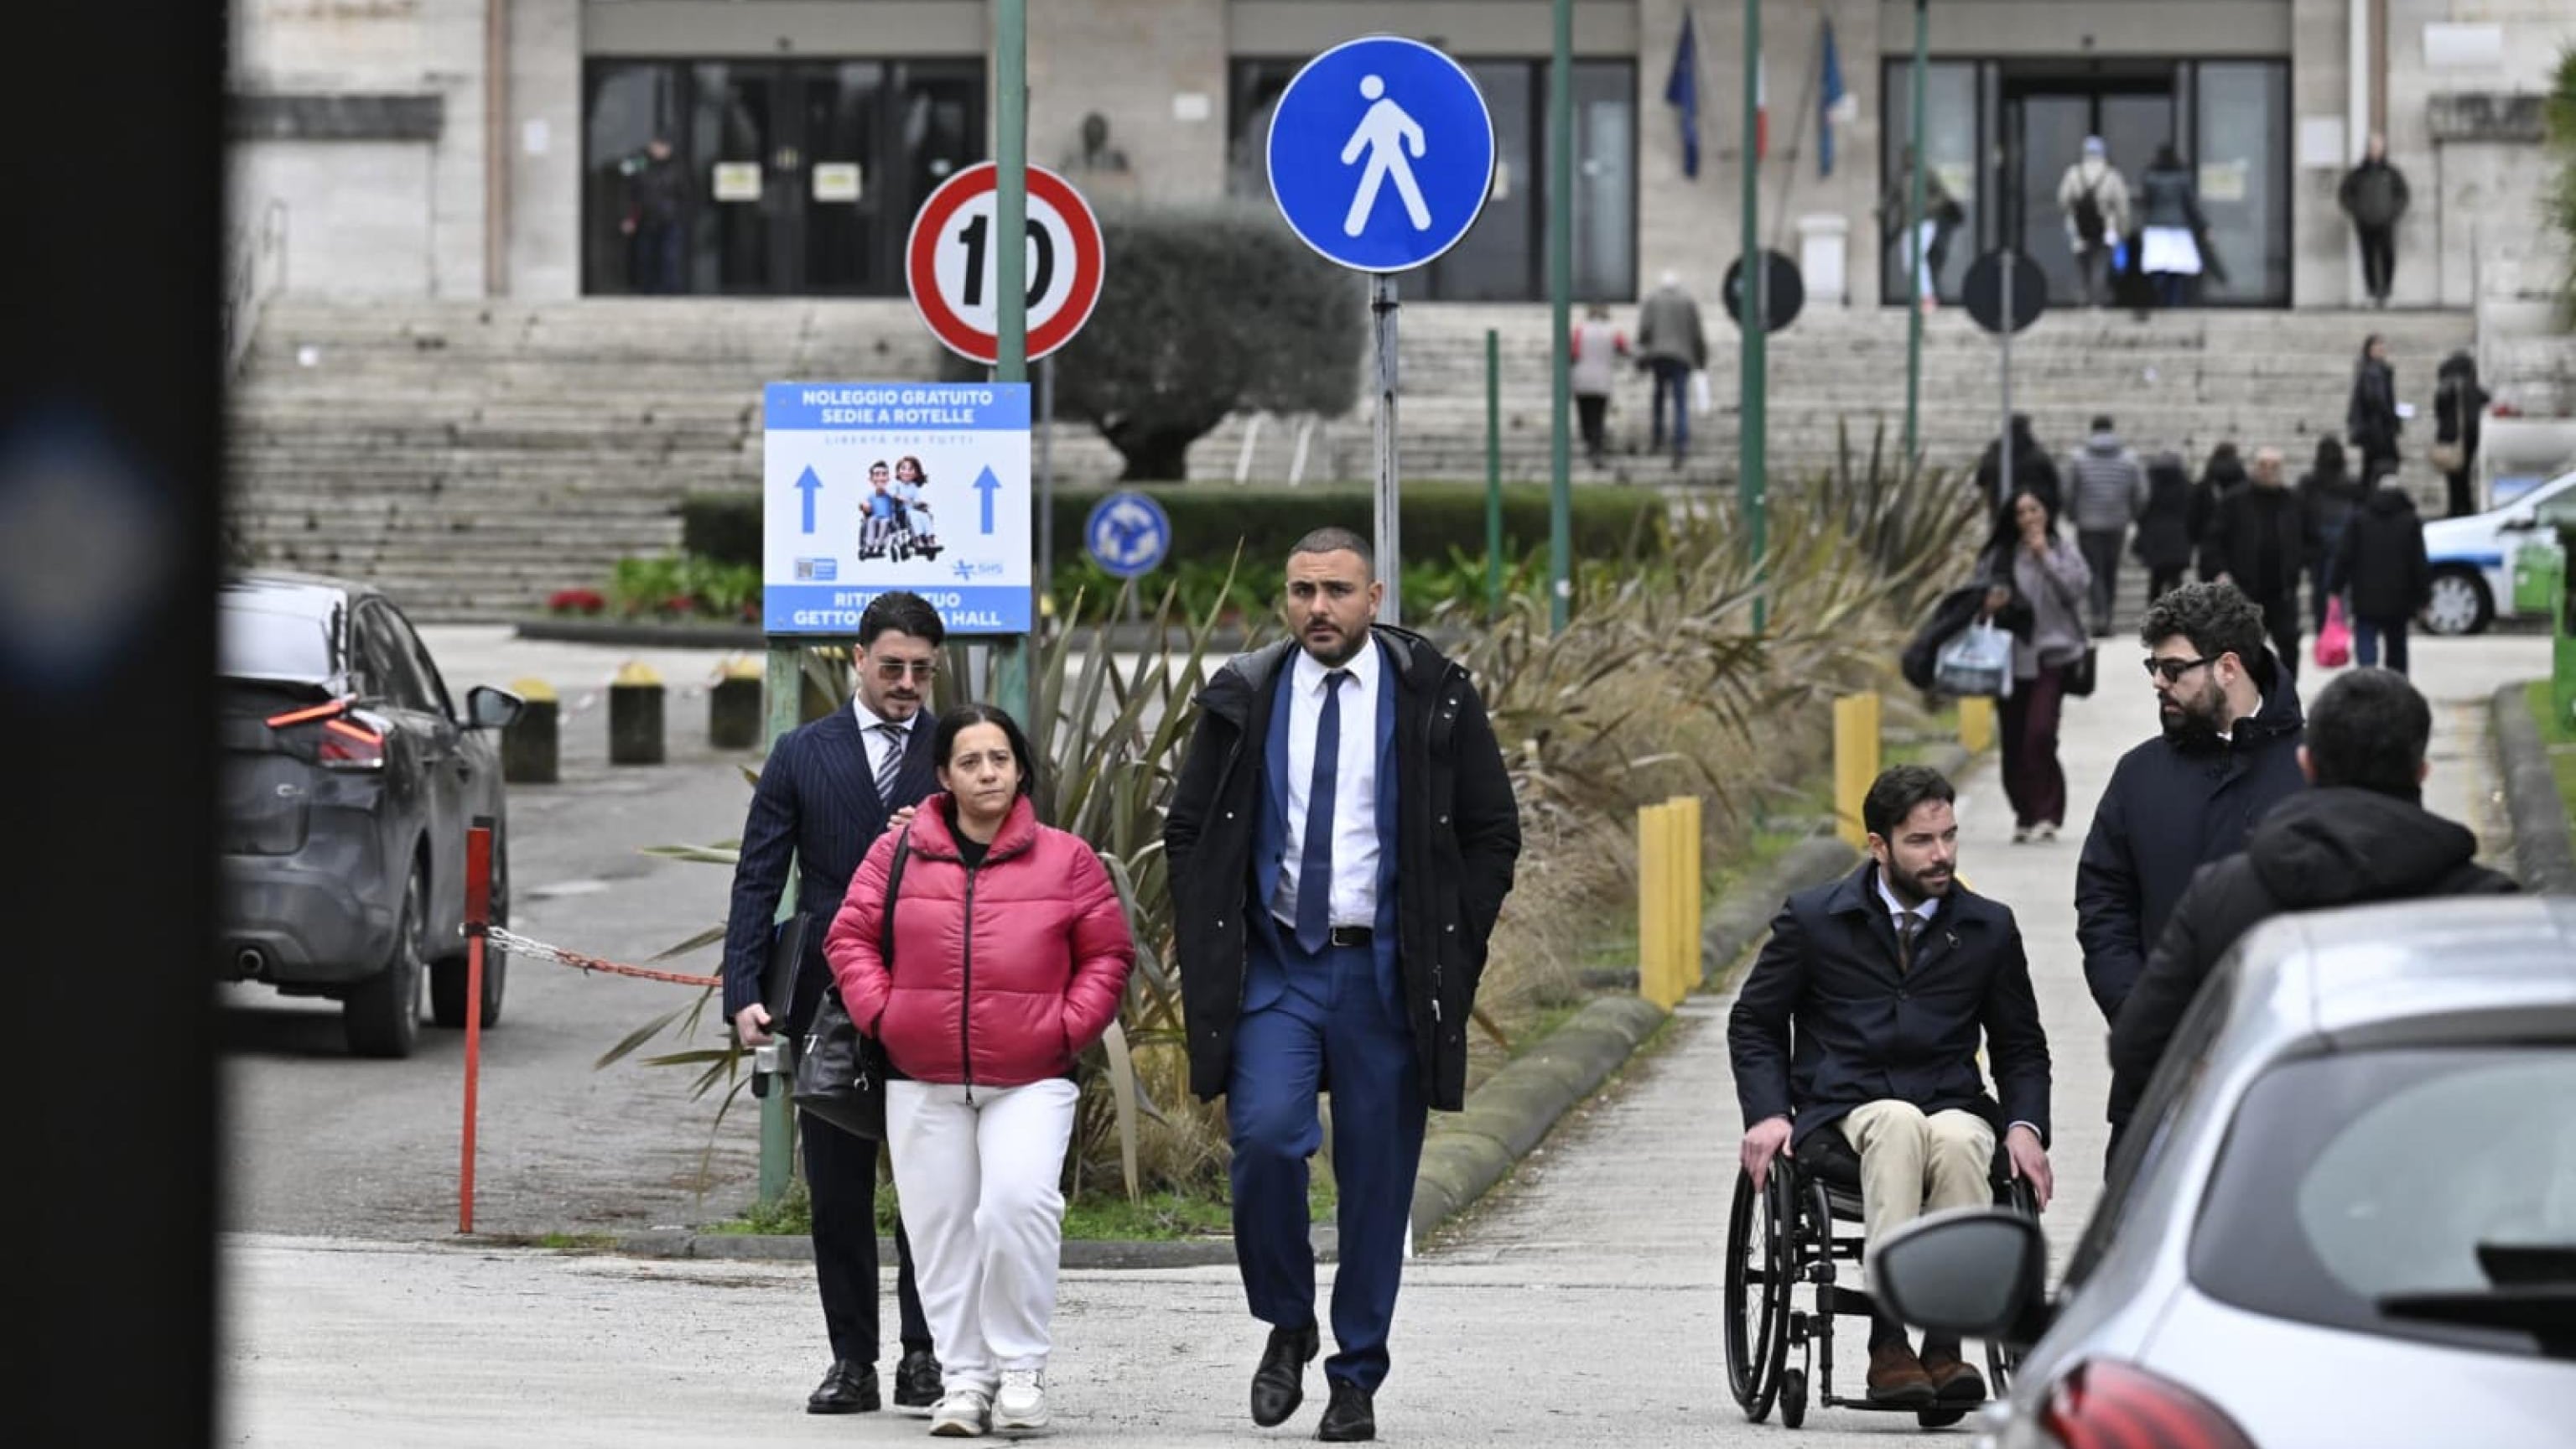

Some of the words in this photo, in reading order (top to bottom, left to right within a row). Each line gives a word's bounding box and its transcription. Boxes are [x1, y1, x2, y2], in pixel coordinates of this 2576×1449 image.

[958, 214, 1054, 309] 10
[802, 389, 897, 406] NOLEGGIO
[901, 389, 993, 406] GRATUITO
[822, 408, 874, 423] SEDIE
[877, 408, 890, 423] A
[894, 408, 974, 423] ROTELLE
[834, 592, 882, 608] RITI
[793, 610, 863, 626] GETTO
[953, 610, 1001, 626] HALL
